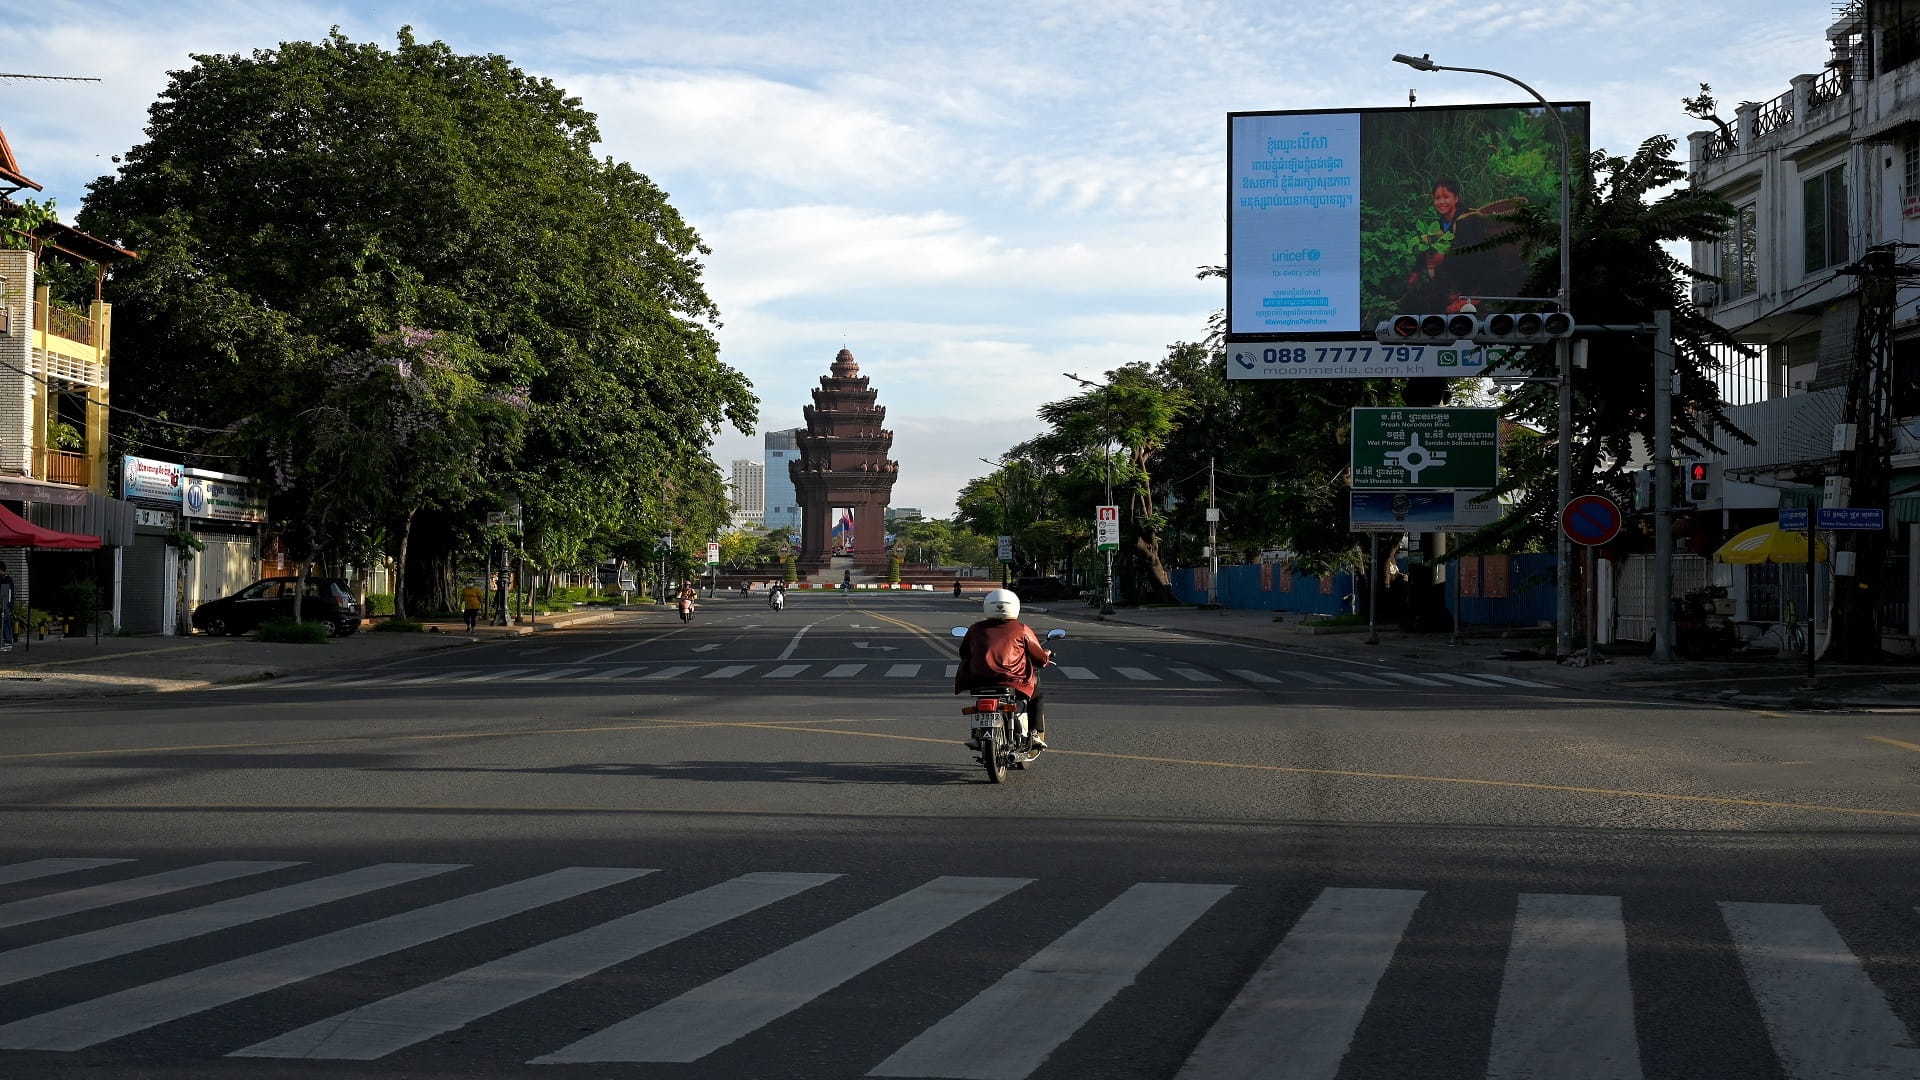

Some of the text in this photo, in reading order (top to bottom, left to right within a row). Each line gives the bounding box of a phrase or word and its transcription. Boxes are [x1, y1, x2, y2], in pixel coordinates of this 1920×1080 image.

[1272, 249, 1306, 261] unicef
[1272, 269, 1321, 278] for every child
[1263, 346, 1426, 364] 088 7777 797
[1263, 364, 1425, 375] moonmedia.com.kh
